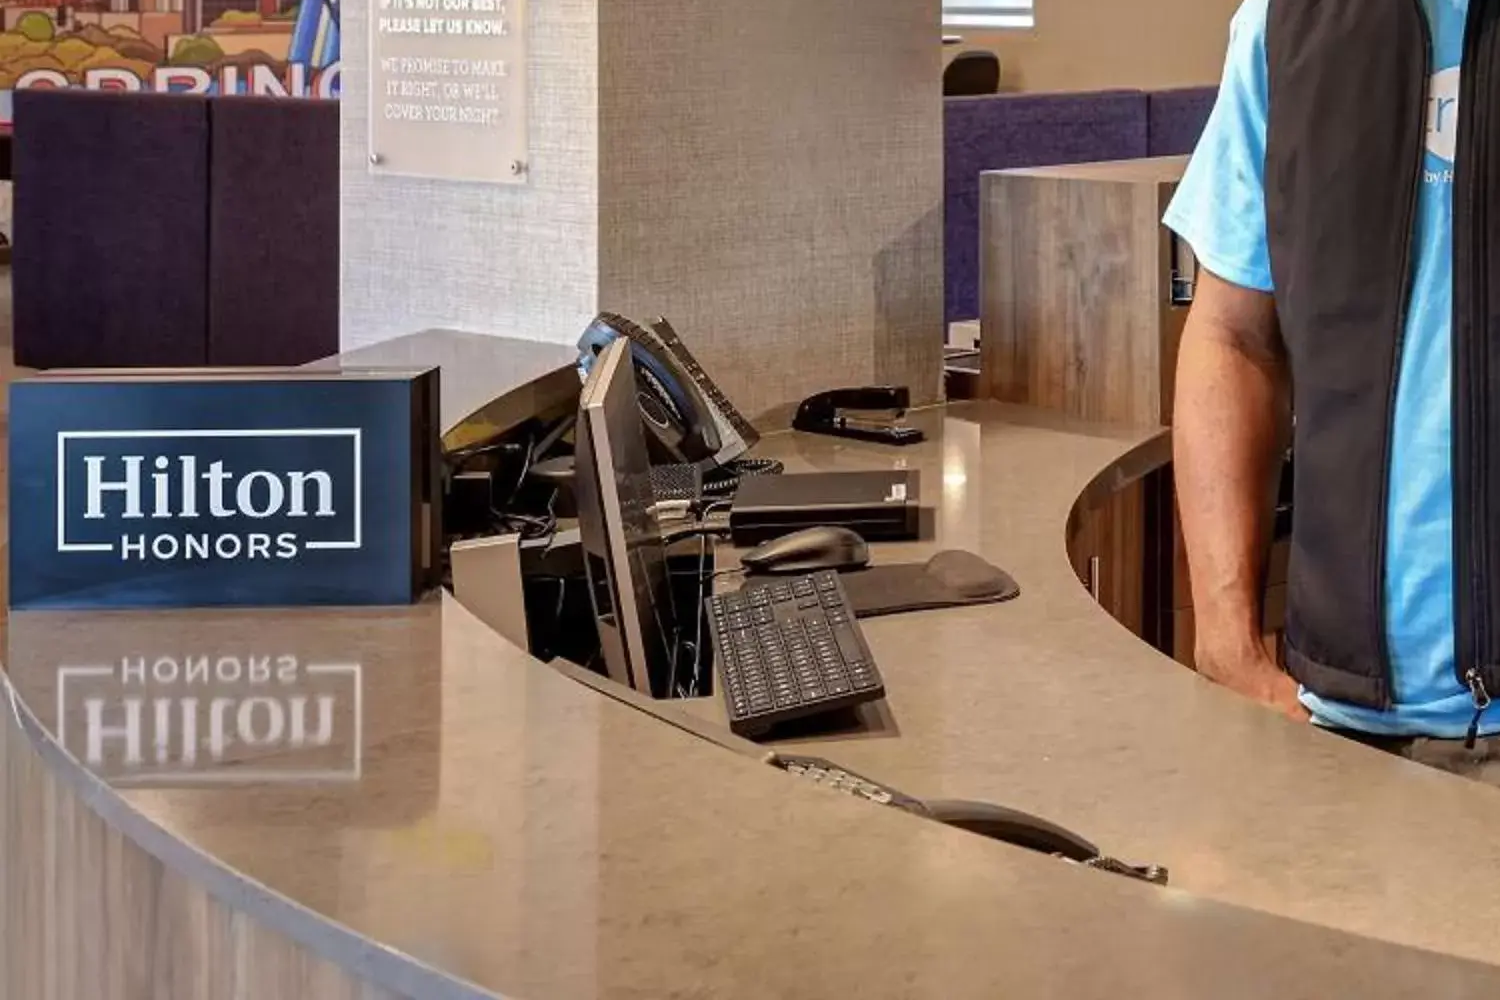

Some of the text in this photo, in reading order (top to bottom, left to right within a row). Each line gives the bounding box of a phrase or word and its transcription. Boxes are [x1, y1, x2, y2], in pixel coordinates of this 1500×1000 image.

[379, 17, 421, 34] PLEASE
[424, 17, 444, 34] LET
[446, 18, 463, 34] US
[452, 59, 469, 75] TO
[425, 105, 456, 122] YOUR
[1424, 169, 1441, 184] by
[84, 455, 336, 518] Hilton
[121, 533, 298, 561] HONORS
